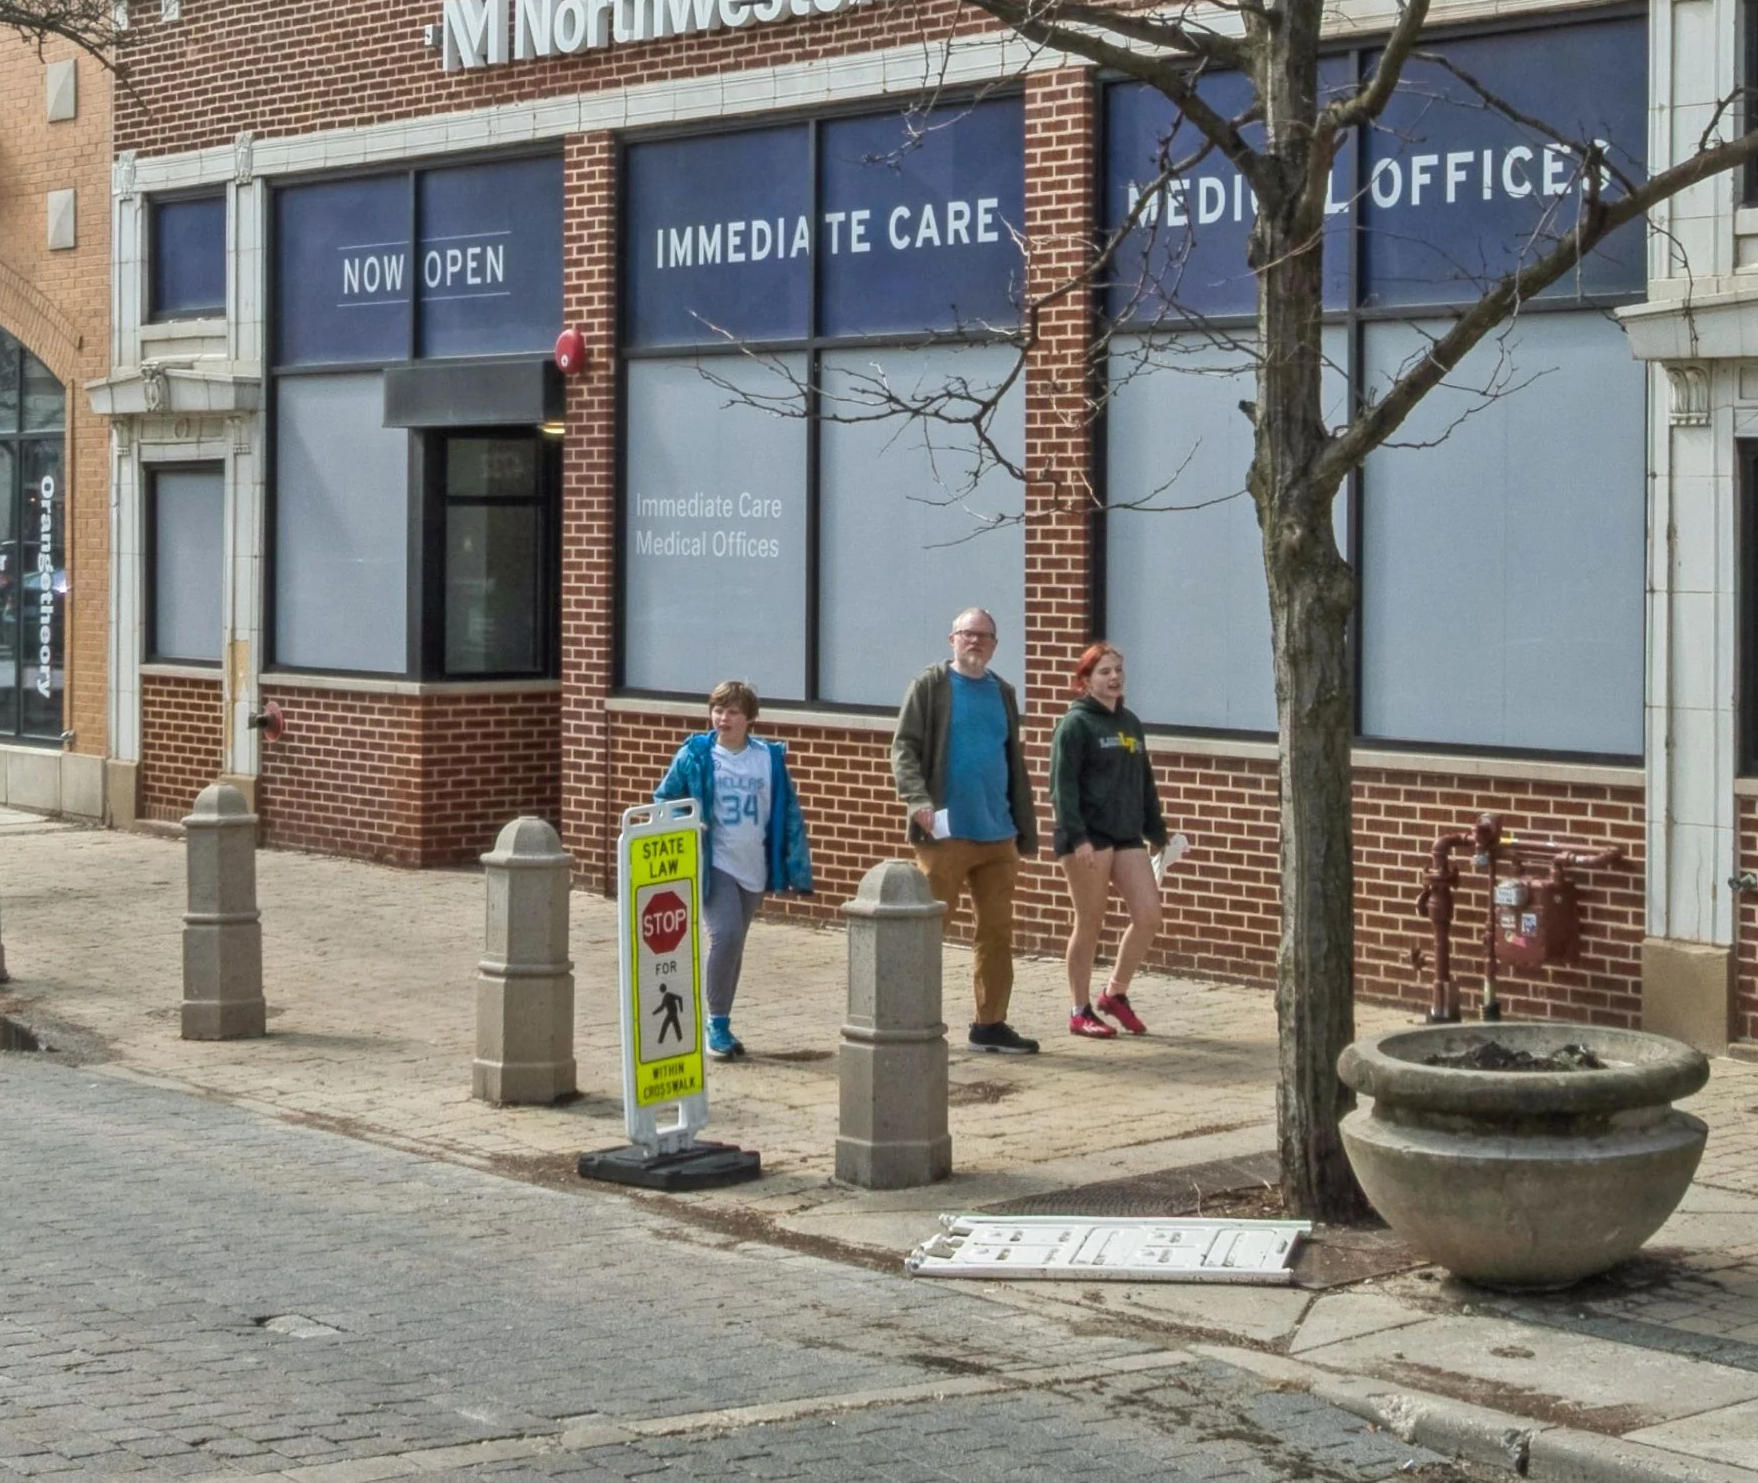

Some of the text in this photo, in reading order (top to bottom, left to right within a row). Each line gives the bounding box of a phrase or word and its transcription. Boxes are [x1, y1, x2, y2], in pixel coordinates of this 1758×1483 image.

[1128, 172, 1350, 229] MEDIL
[656, 197, 999, 269] IMMEDIATE CARE
[343, 244, 504, 295] NOW OPEN
[636, 491, 782, 518] Immediate Care
[636, 530, 779, 558] Medical Offices
[37, 475, 55, 700] Orangetheory
[722, 794, 758, 827] 34
[643, 837, 684, 859] STATE
[650, 859, 679, 878] LAW
[643, 908, 687, 937] STOP
[655, 960, 678, 976] FOR
[653, 1061, 684, 1079] WITHIN
[644, 1076, 696, 1100] CROSSWALK
